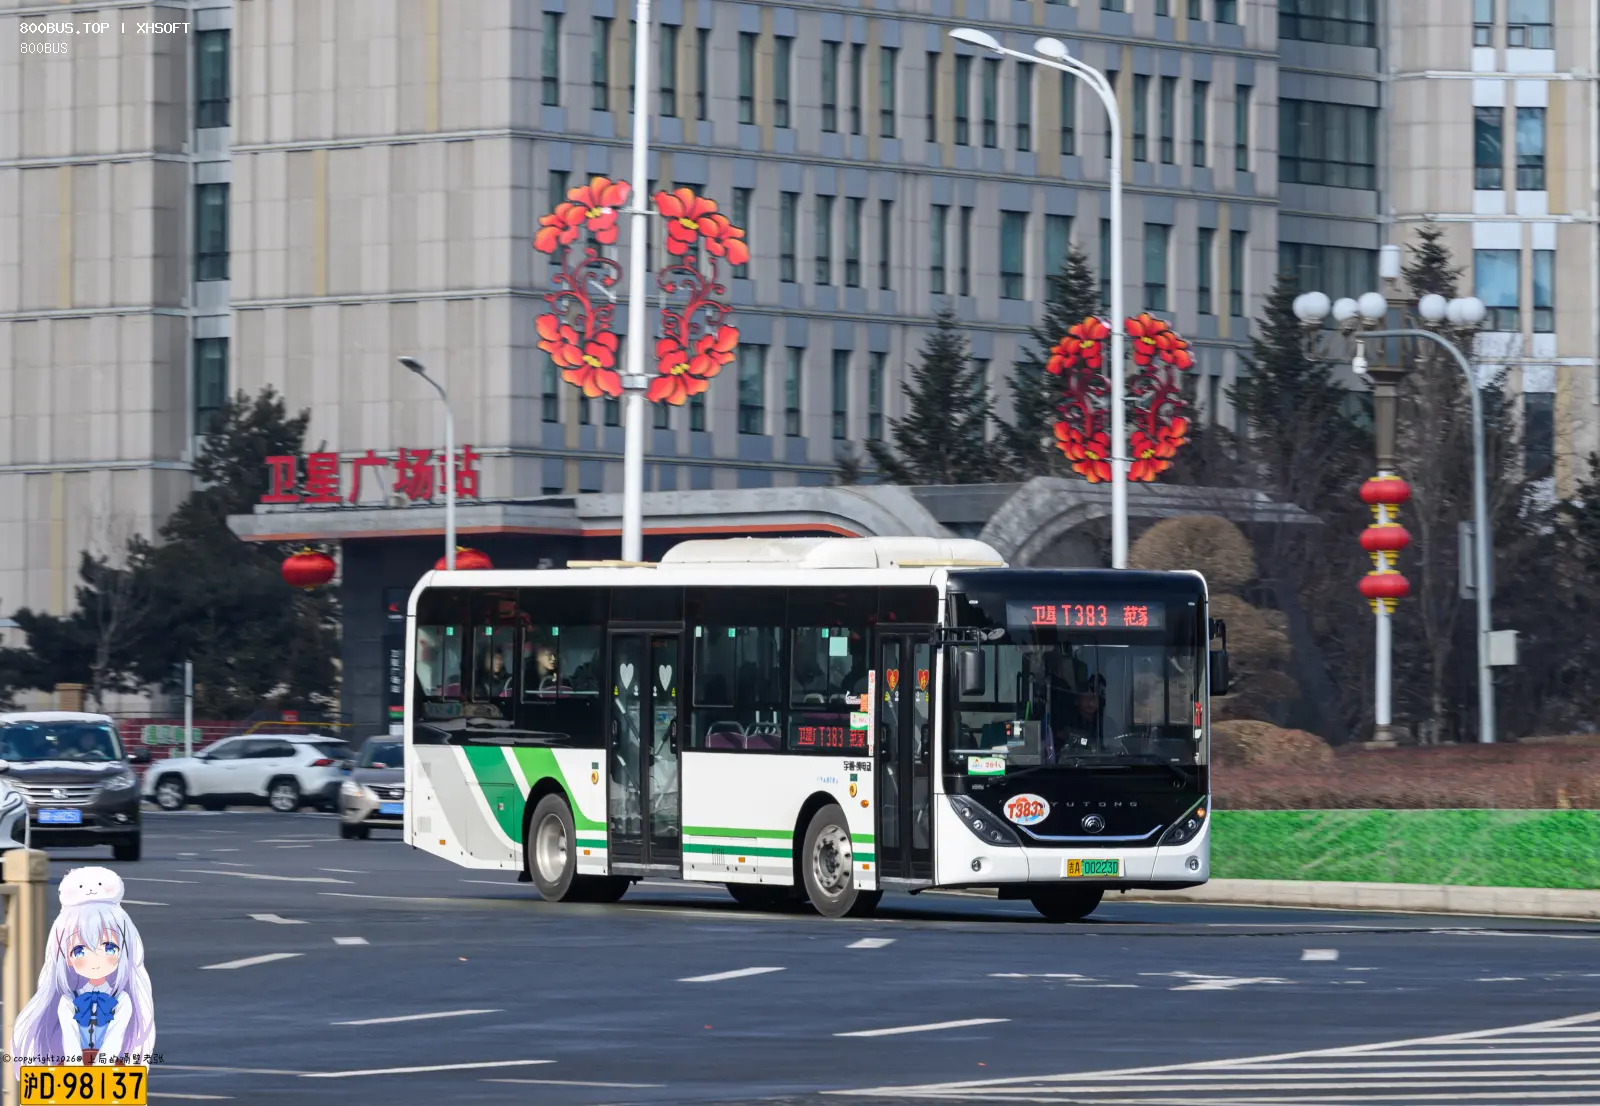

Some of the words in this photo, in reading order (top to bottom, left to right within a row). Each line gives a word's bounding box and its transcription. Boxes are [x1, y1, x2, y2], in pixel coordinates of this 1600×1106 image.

[260, 444, 480, 503] 卫星广场站
[1031, 605, 1057, 625] 卫星
[1061, 604, 1107, 627] T383
[1123, 605, 1148, 627] 范家
[819, 726, 844, 747] T383
[1007, 800, 1039, 819] T383
